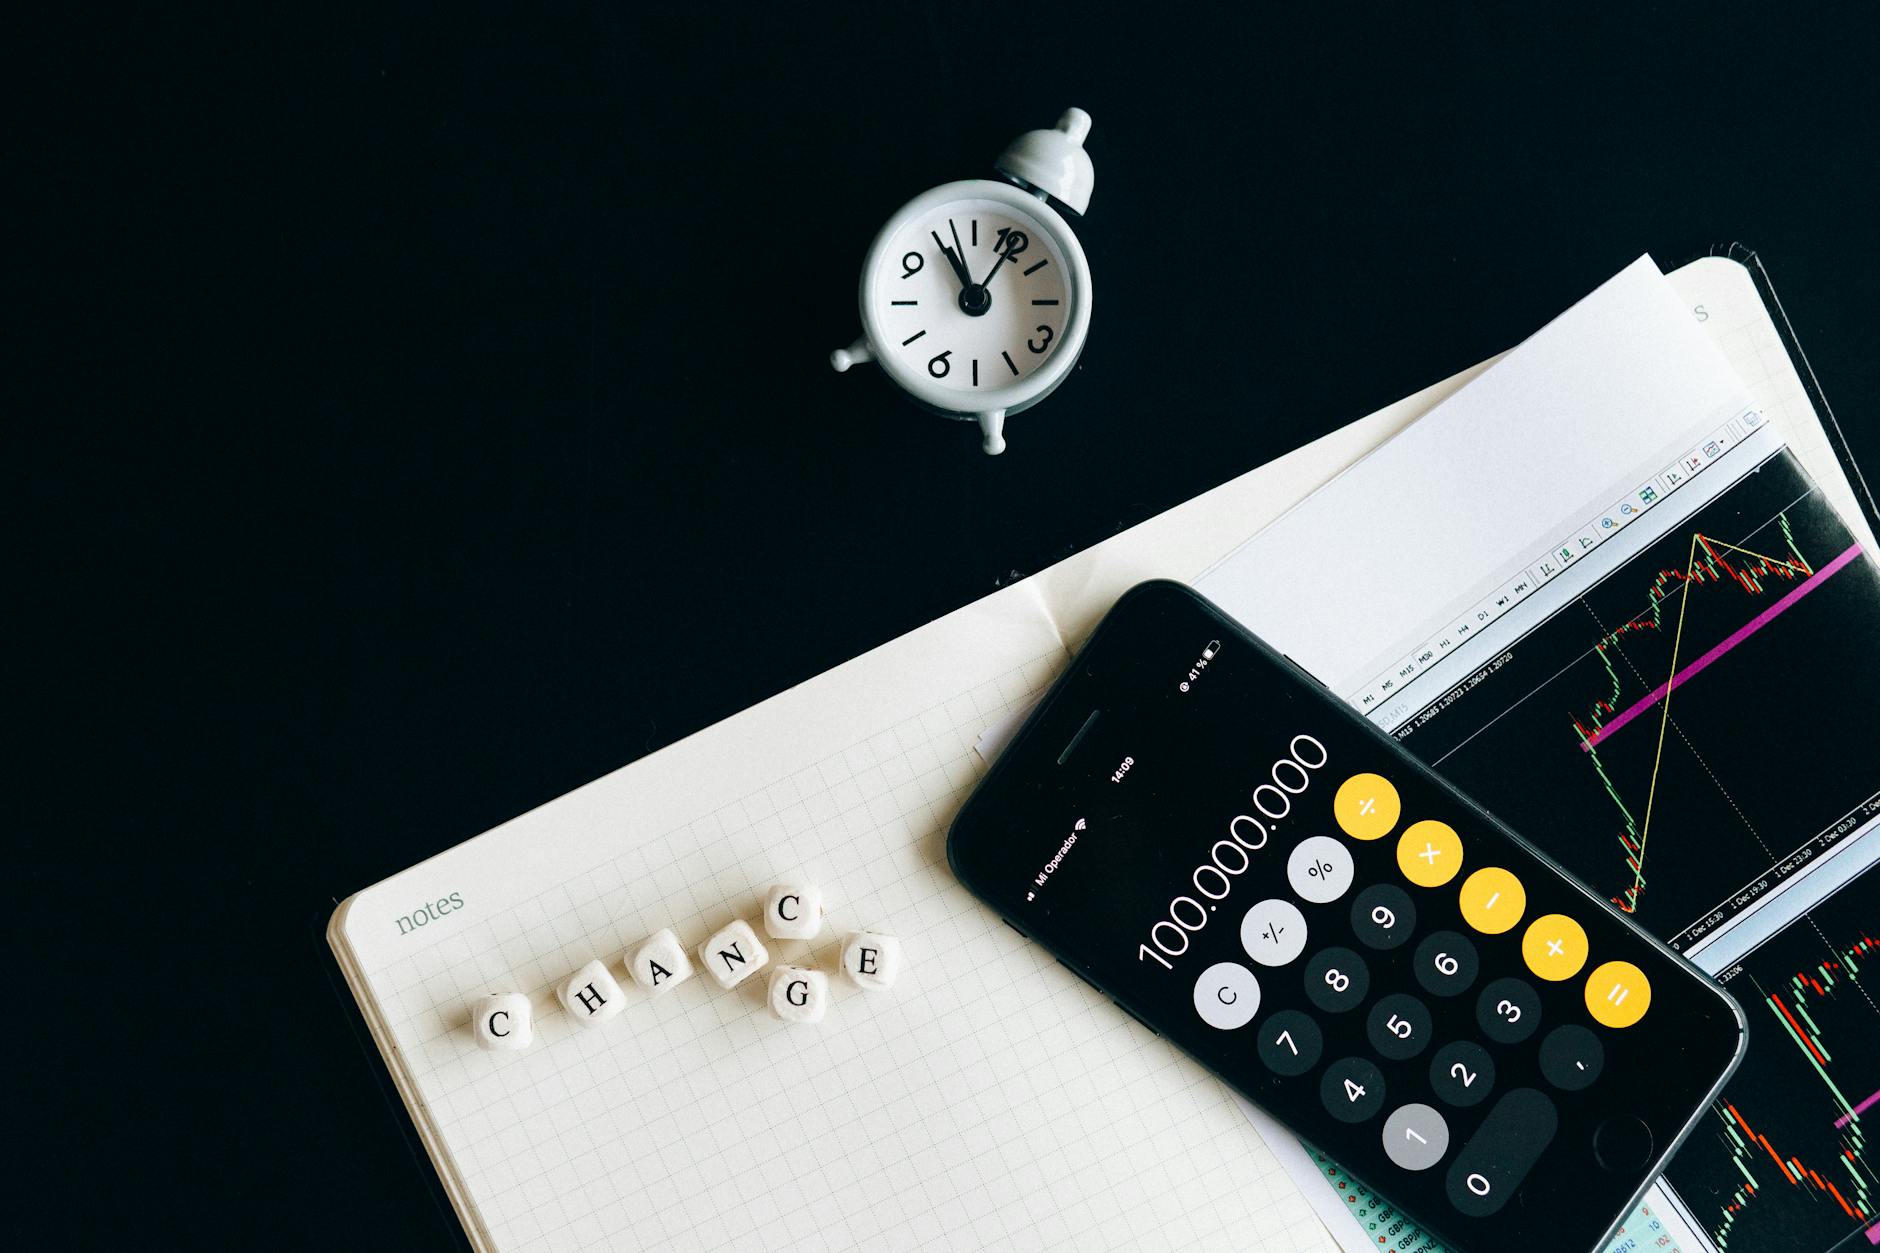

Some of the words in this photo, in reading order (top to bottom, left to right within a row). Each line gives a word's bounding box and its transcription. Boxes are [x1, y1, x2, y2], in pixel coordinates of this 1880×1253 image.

[993, 227, 1029, 263] 12
[901, 251, 924, 279] 9
[1027, 324, 1054, 354] 3
[927, 350, 953, 379] 6
[1363, 694, 1375, 705] M1
[1382, 680, 1393, 691] M5
[1400, 664, 1414, 678] M15
[1418, 650, 1433, 664] M30
[1439, 638, 1450, 648] H1
[1458, 625, 1469, 635] H4
[1477, 610, 1489, 621] D1
[1188, 668, 1200, 681] 41
[1111, 756, 1134, 783] 14:09
[1818, 839, 1825, 847] 2
[1824, 830, 1839, 843] Dec
[1837, 817, 1856, 833] 03:30
[1034, 872, 1048, 887] Mi
[1044, 832, 1078, 874] Operador
[1139, 734, 1328, 970] 100.000.000
[1774, 870, 1781, 878] 1
[1779, 862, 1795, 875] Dec
[1793, 848, 1812, 865] 23:30
[1735, 893, 1750, 905] Dec
[1749, 880, 1768, 896] 19:30
[395, 889, 464, 936] notes
[1691, 925, 1706, 937] Dec
[1705, 911, 1724, 928] 15:30
[1217, 986, 1237, 1005] C
[1308, 859, 1333, 881] %
[1275, 1030, 1299, 1056] 7
[1324, 968, 1350, 992] 8
[1371, 906, 1396, 929] 9
[1343, 1078, 1366, 1102] 4
[1386, 1014, 1412, 1039] 5
[1434, 952, 1459, 976] 6
[1406, 1127, 1427, 1145] 1
[1450, 1062, 1477, 1087] 2
[1497, 1000, 1521, 1023] 3
[1466, 1173, 1491, 1196] 0
